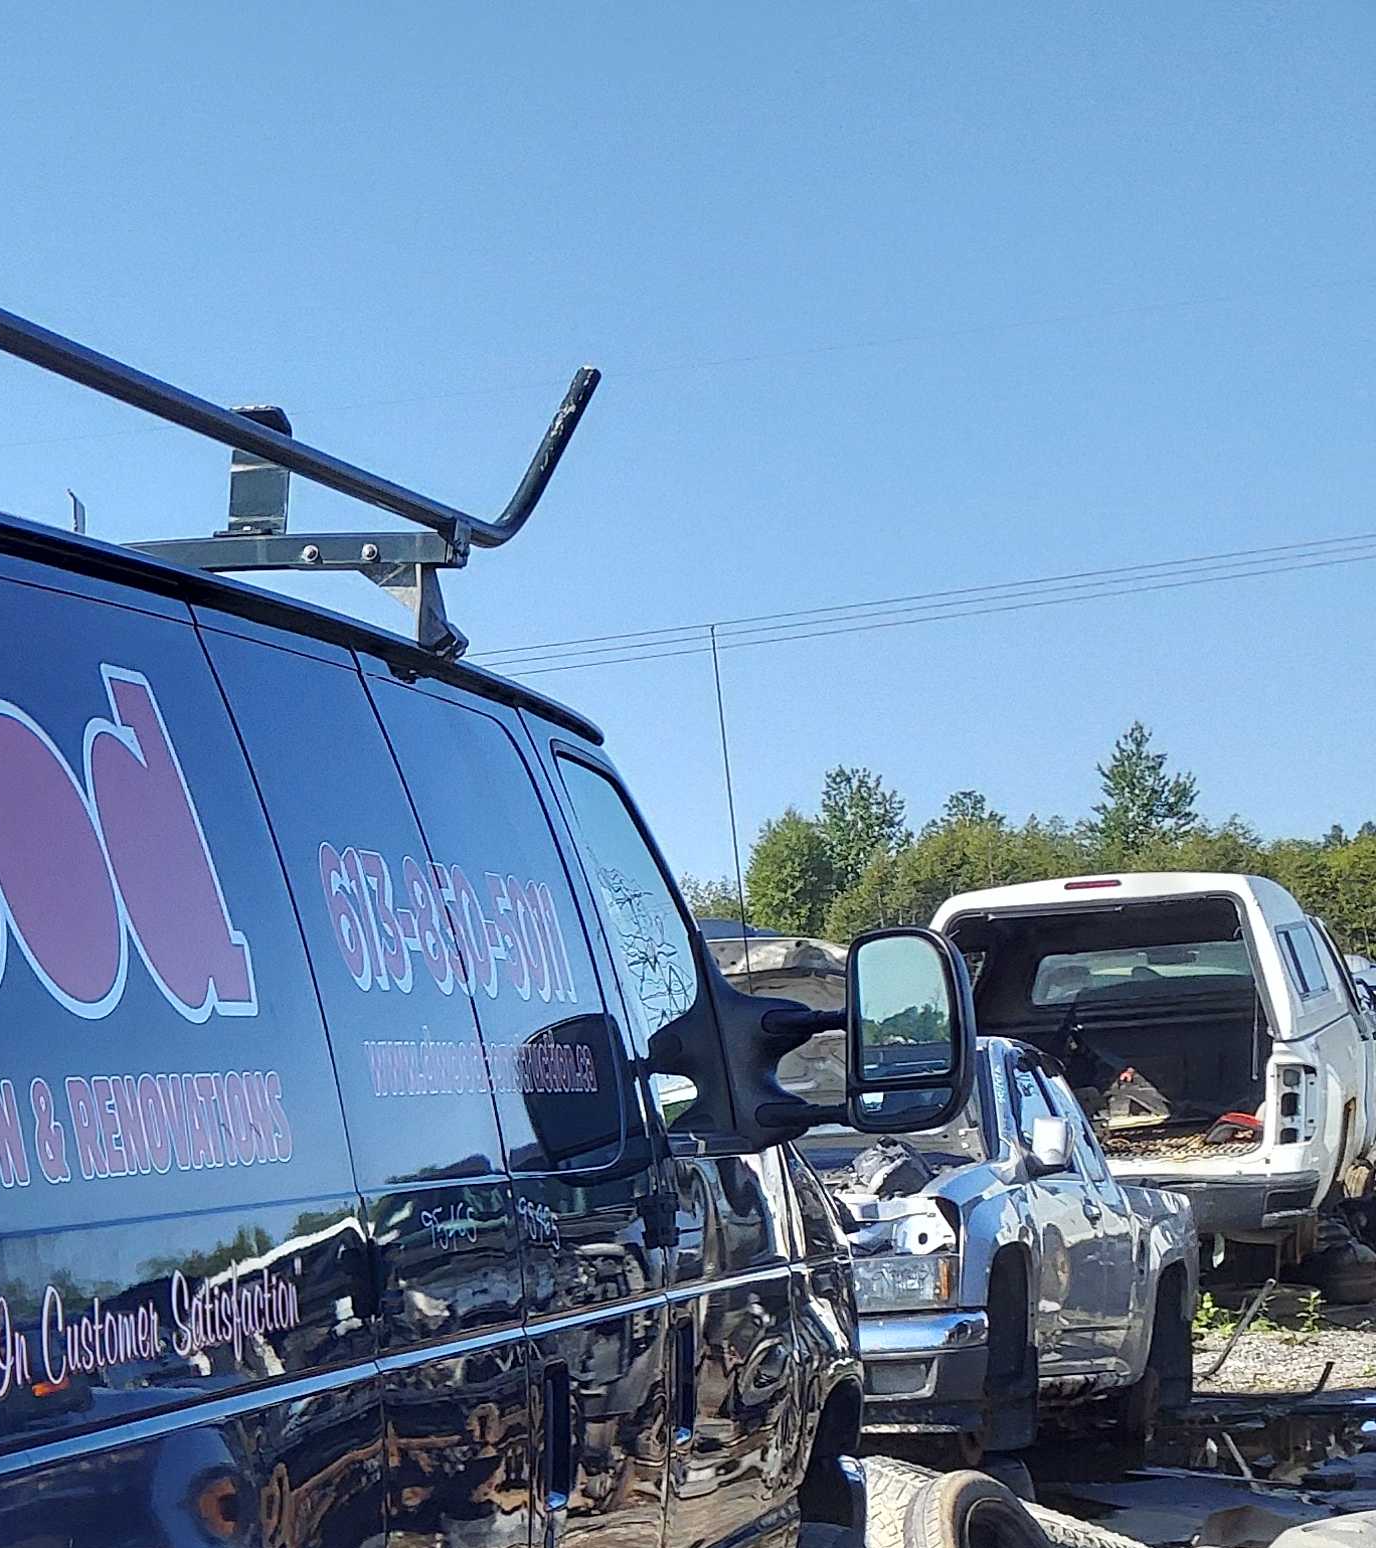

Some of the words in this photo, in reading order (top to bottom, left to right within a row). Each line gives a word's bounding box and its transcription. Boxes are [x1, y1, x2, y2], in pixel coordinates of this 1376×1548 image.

[318, 841, 579, 1005] 613-850-5011
[30, 1075, 72, 1184] &
[65, 1070, 294, 1181] RENOVATIONS
[41, 1285, 160, 1386] Customer
